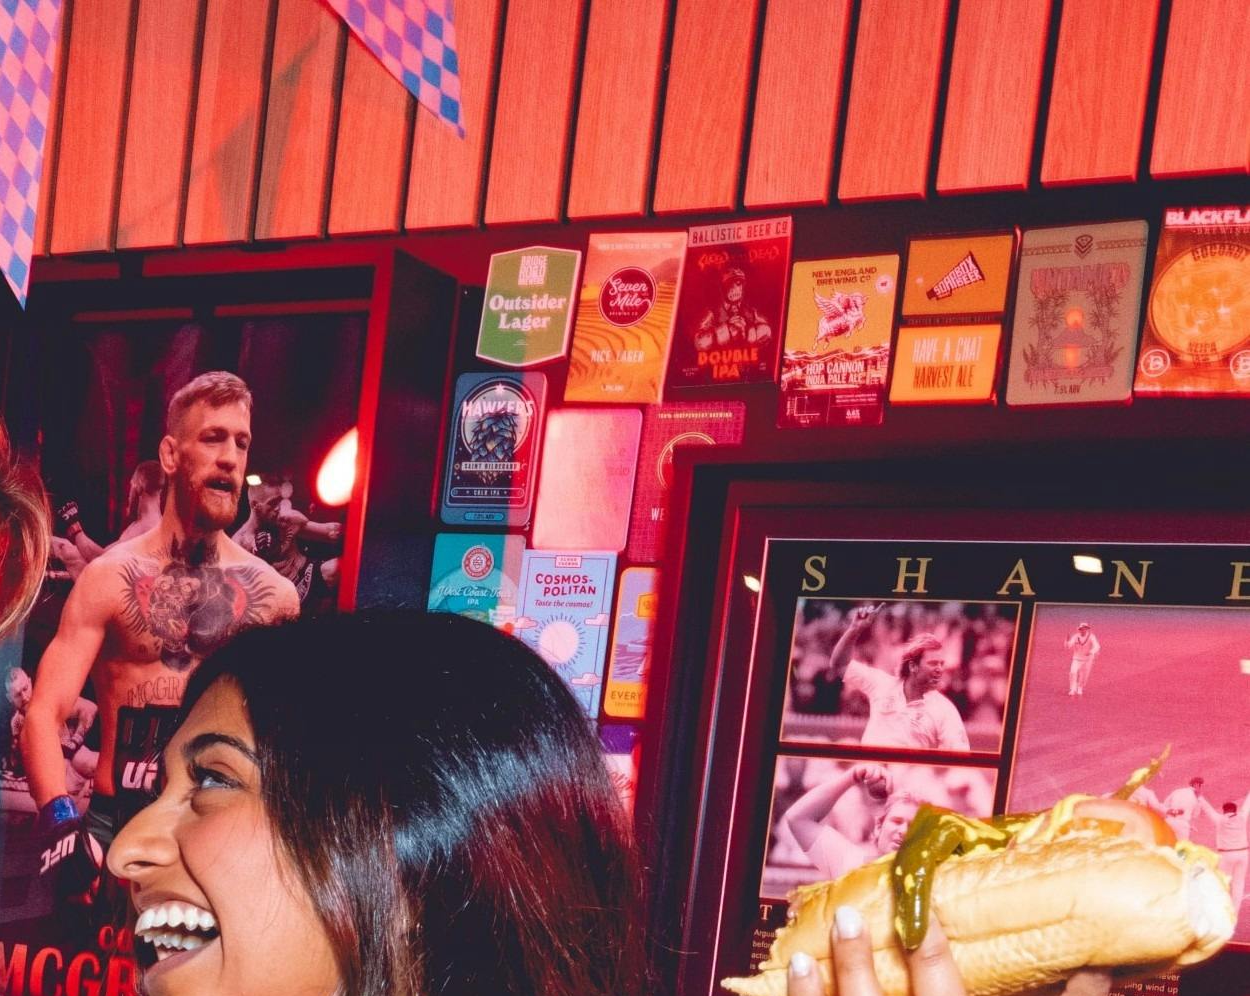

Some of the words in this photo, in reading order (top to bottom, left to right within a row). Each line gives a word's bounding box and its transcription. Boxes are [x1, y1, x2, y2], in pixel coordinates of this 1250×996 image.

[692, 226, 743, 245] BALLISTIC
[747, 223, 772, 239] BEER
[812, 270, 832, 280] NEW
[833, 266, 877, 277] ENGLAND
[816, 275, 858, 287] BREWING
[934, 255, 977, 296] SOAPBOX
[955, 269, 983, 286] BEER
[607, 277, 648, 297] Seven
[489, 293, 567, 312] Outsider
[609, 293, 651, 313] Mile
[498, 313, 551, 333] Lager
[697, 347, 759, 365] DOUBLE
[912, 338, 938, 363] HAVE
[942, 338, 951, 361] A
[954, 336, 983, 361] CHAT
[711, 364, 740, 380] IPA
[806, 362, 825, 376] HOP
[826, 361, 865, 374] CANNON
[912, 366, 955, 389] HARVEST
[956, 364, 975, 388] ALE
[805, 374, 826, 386] INDIA
[827, 372, 848, 385] PALE
[849, 371, 866, 384] ALE
[461, 400, 535, 418] HAWKERS
[462, 585, 490, 597] Coast
[543, 585, 597, 597] POLITAN
[467, 598, 480, 606] IPA
[535, 599, 552, 607] Taste
[553, 599, 564, 607] the
[565, 599, 593, 609] cosmos!
[1145, 983, 1165, 992] wind
[1167, 986, 1179, 995] up
